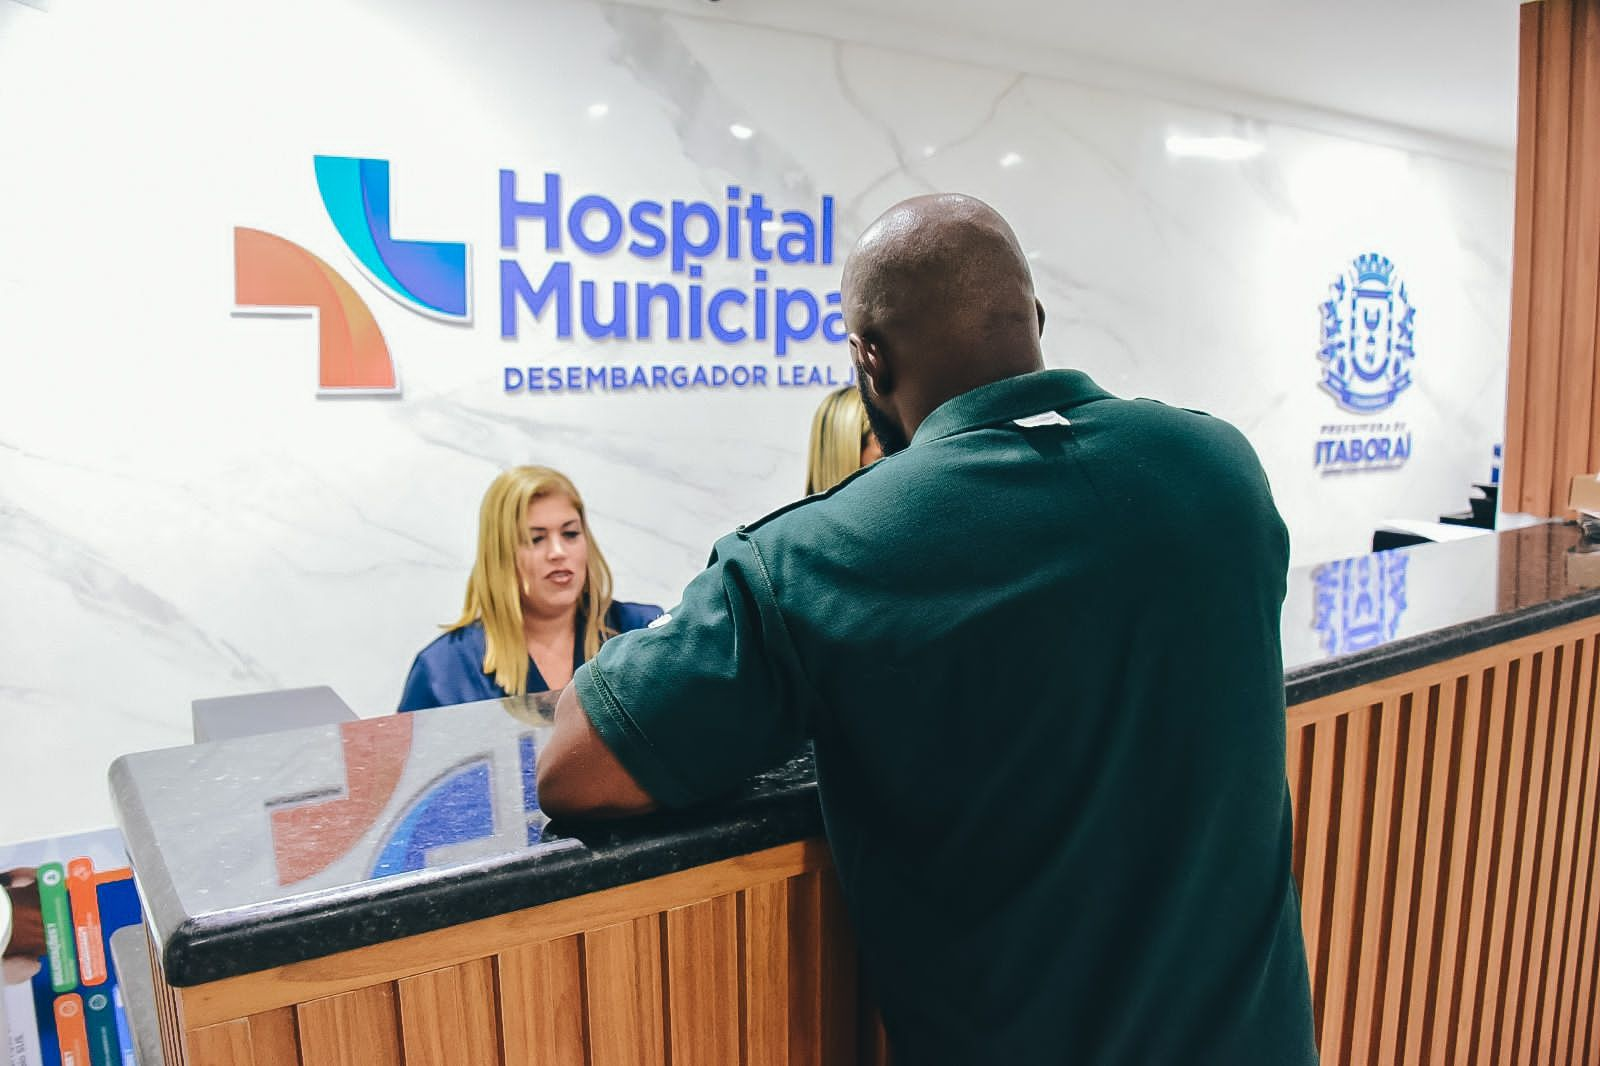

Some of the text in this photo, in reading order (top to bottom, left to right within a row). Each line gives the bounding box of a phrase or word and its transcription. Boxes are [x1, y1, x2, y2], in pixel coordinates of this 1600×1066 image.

[499, 168, 835, 273] Hospital
[499, 259, 849, 358] Municipa
[504, 364, 768, 392] DESEMBARGADOR
[777, 367, 838, 387] LEAL
